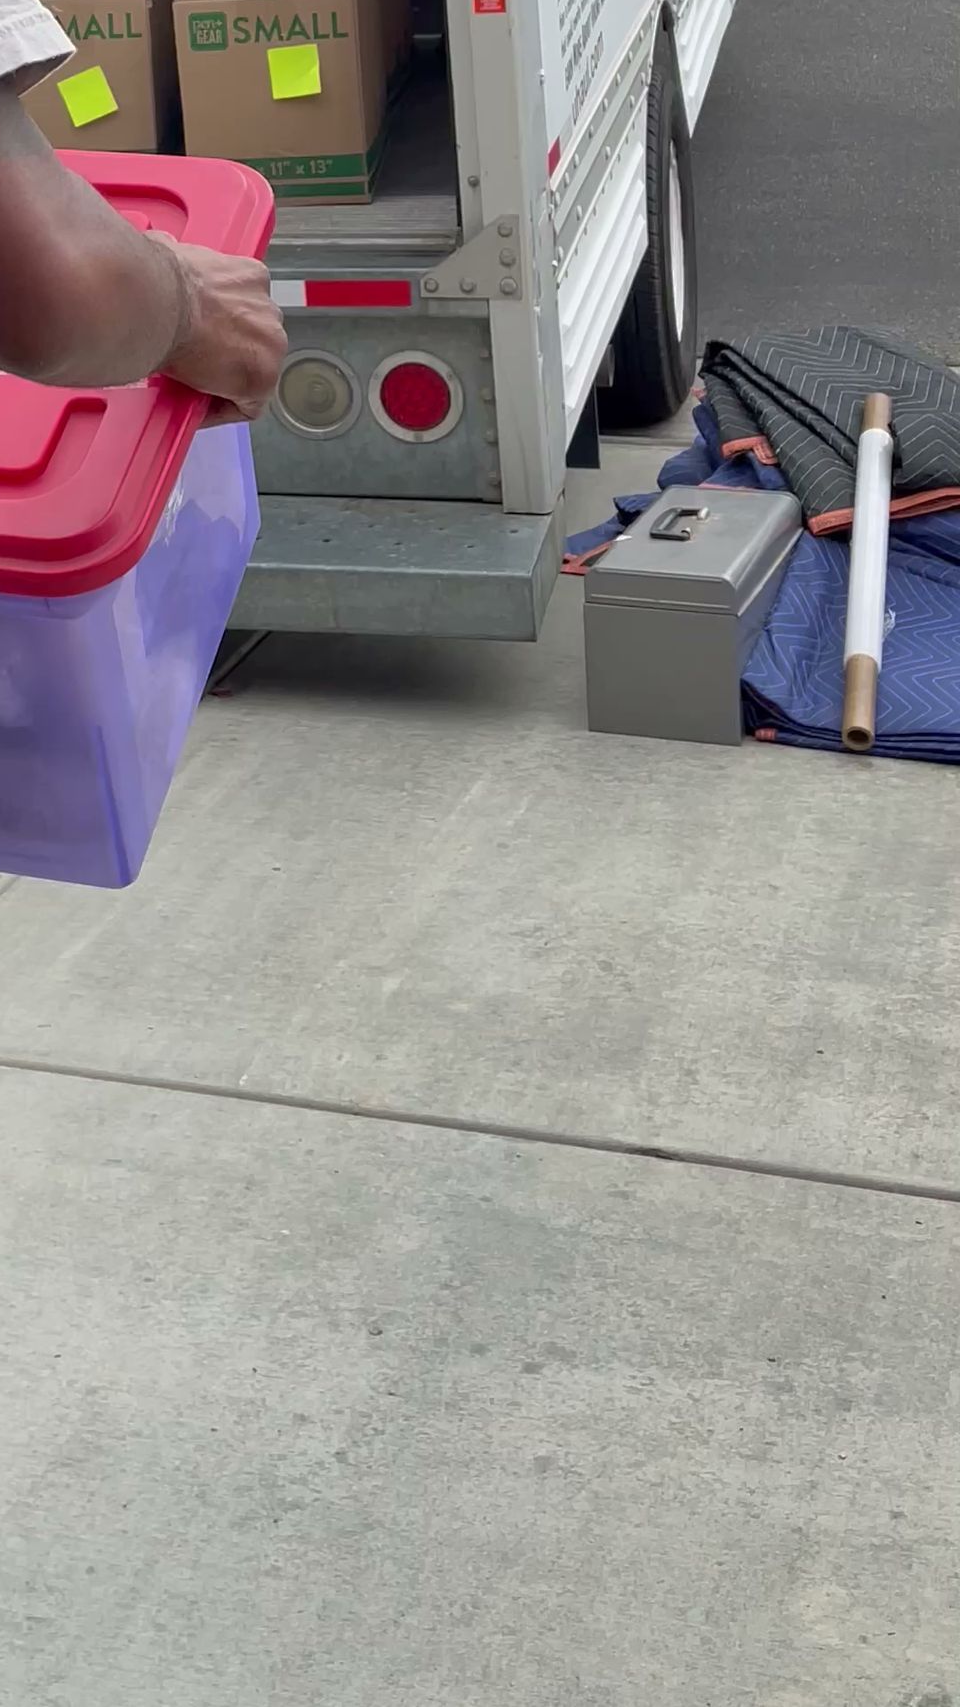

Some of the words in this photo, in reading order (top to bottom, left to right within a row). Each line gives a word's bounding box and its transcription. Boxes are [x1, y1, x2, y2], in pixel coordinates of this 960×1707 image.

[54, 12, 143, 41] MALL
[232, 11, 349, 44] SMALL
[310, 159, 333, 174] 13"
